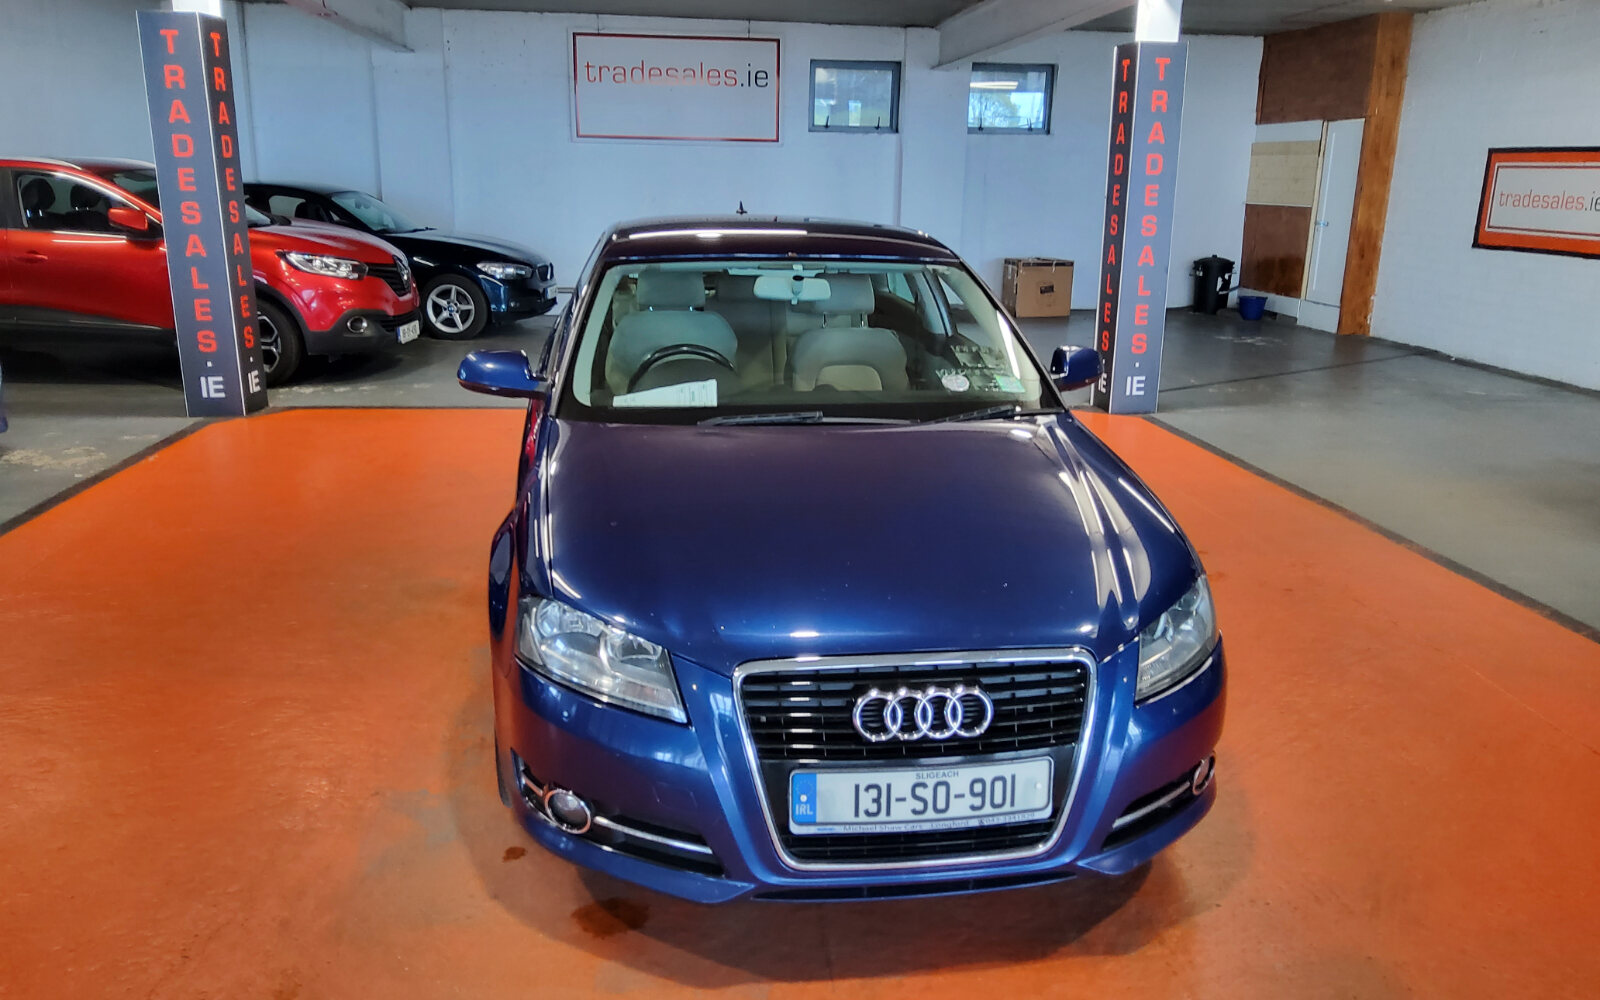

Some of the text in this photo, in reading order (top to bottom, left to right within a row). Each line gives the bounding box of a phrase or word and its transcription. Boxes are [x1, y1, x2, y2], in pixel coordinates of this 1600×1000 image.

[584, 60, 769, 88] tradesales.ie
[915, 770, 960, 780] SLIGEACH
[854, 774, 1016, 818] 131-SO-901
[795, 804, 814, 816] IRL
